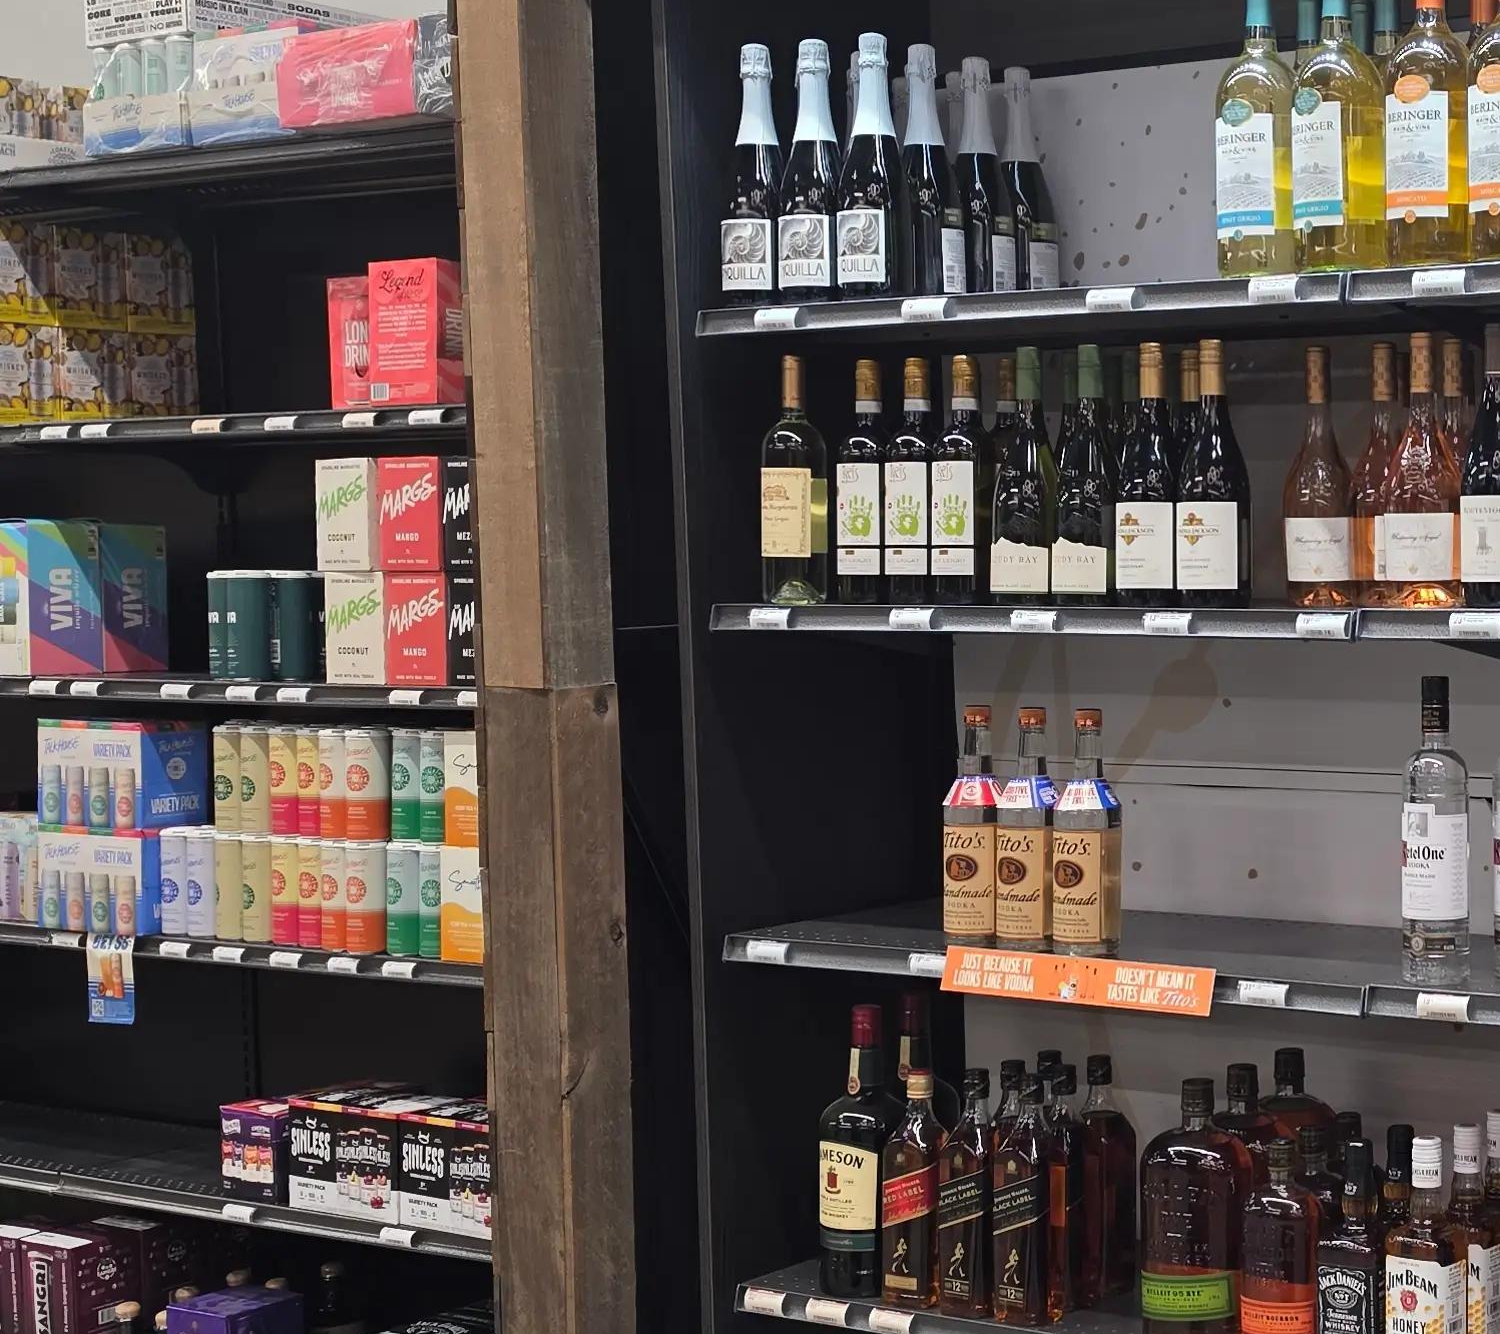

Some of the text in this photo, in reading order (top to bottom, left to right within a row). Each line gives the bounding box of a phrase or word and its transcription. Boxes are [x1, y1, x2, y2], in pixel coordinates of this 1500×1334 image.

[287, 3, 331, 18] SODAS
[1388, 109, 1442, 124] BERINGER
[379, 268, 425, 293] Legend
[328, 533, 355, 542] COCONUT
[395, 532, 419, 542] MANGO
[50, 568, 73, 632] VIVA
[121, 568, 143, 629] VIVA
[338, 647, 368, 655] COCONUT
[403, 647, 427, 657] MANGO
[93, 743, 132, 759] VARIETY PACK
[151, 794, 200, 815] VARIETY PACK
[961, 952, 1033, 973] JUST BECAUSE IT
[953, 968, 1034, 993] LOOKS LIKE VODKA
[1115, 967, 1196, 990] DOESN'T MEAN IT
[1107, 984, 1199, 1008] TASTES LIKE Tito's
[291, 1127, 331, 1163] SINLESS
[402, 1142, 444, 1179] SINLESS
[899, 1186, 924, 1200] LABEL
[1007, 1288, 1016, 1299] 12
[1318, 1271, 1367, 1297] JACK DANIEL'S
[1387, 1269, 1438, 1298] JIM BEAM
[1325, 1321, 1361, 1334] WHISKEY
